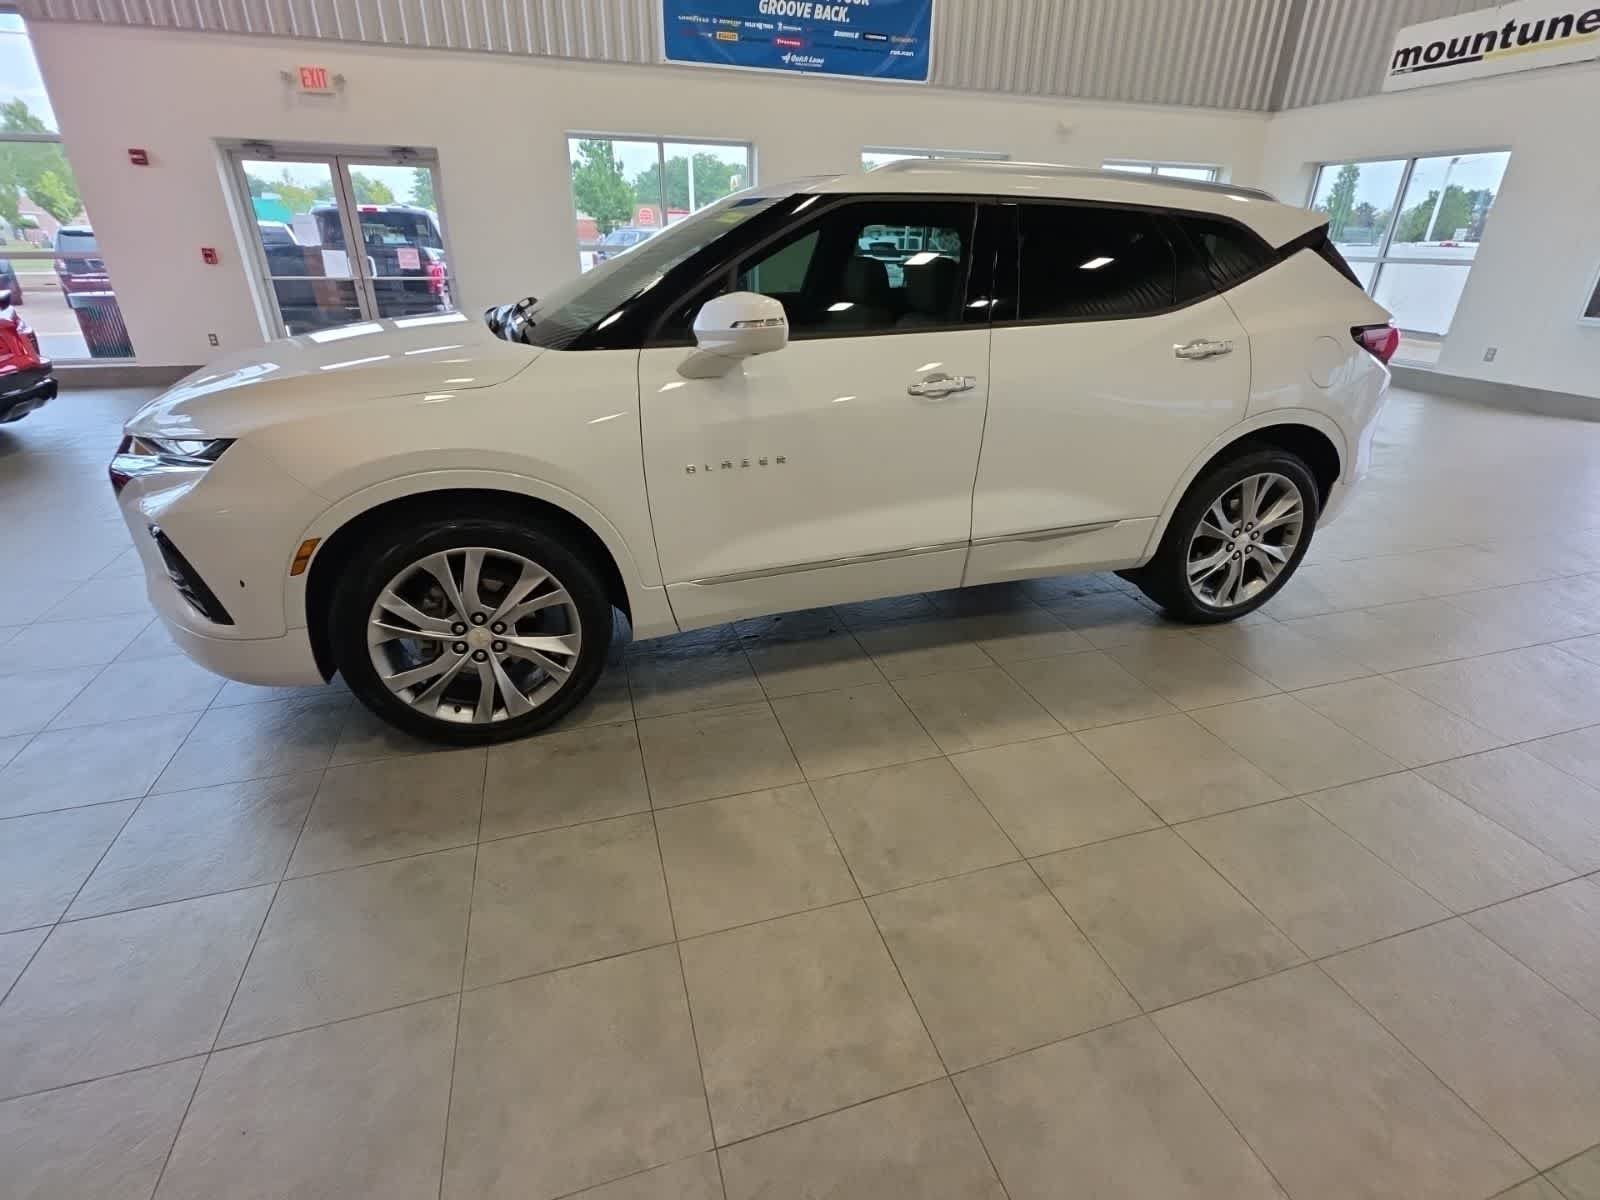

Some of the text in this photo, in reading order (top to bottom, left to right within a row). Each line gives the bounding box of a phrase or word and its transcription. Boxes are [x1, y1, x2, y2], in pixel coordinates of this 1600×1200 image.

[758, 0, 849, 22] GROOVE BACK.
[1391, 8, 1600, 69] mountune
[299, 67, 327, 88] EXIT
[685, 455, 787, 473] BLAZER
